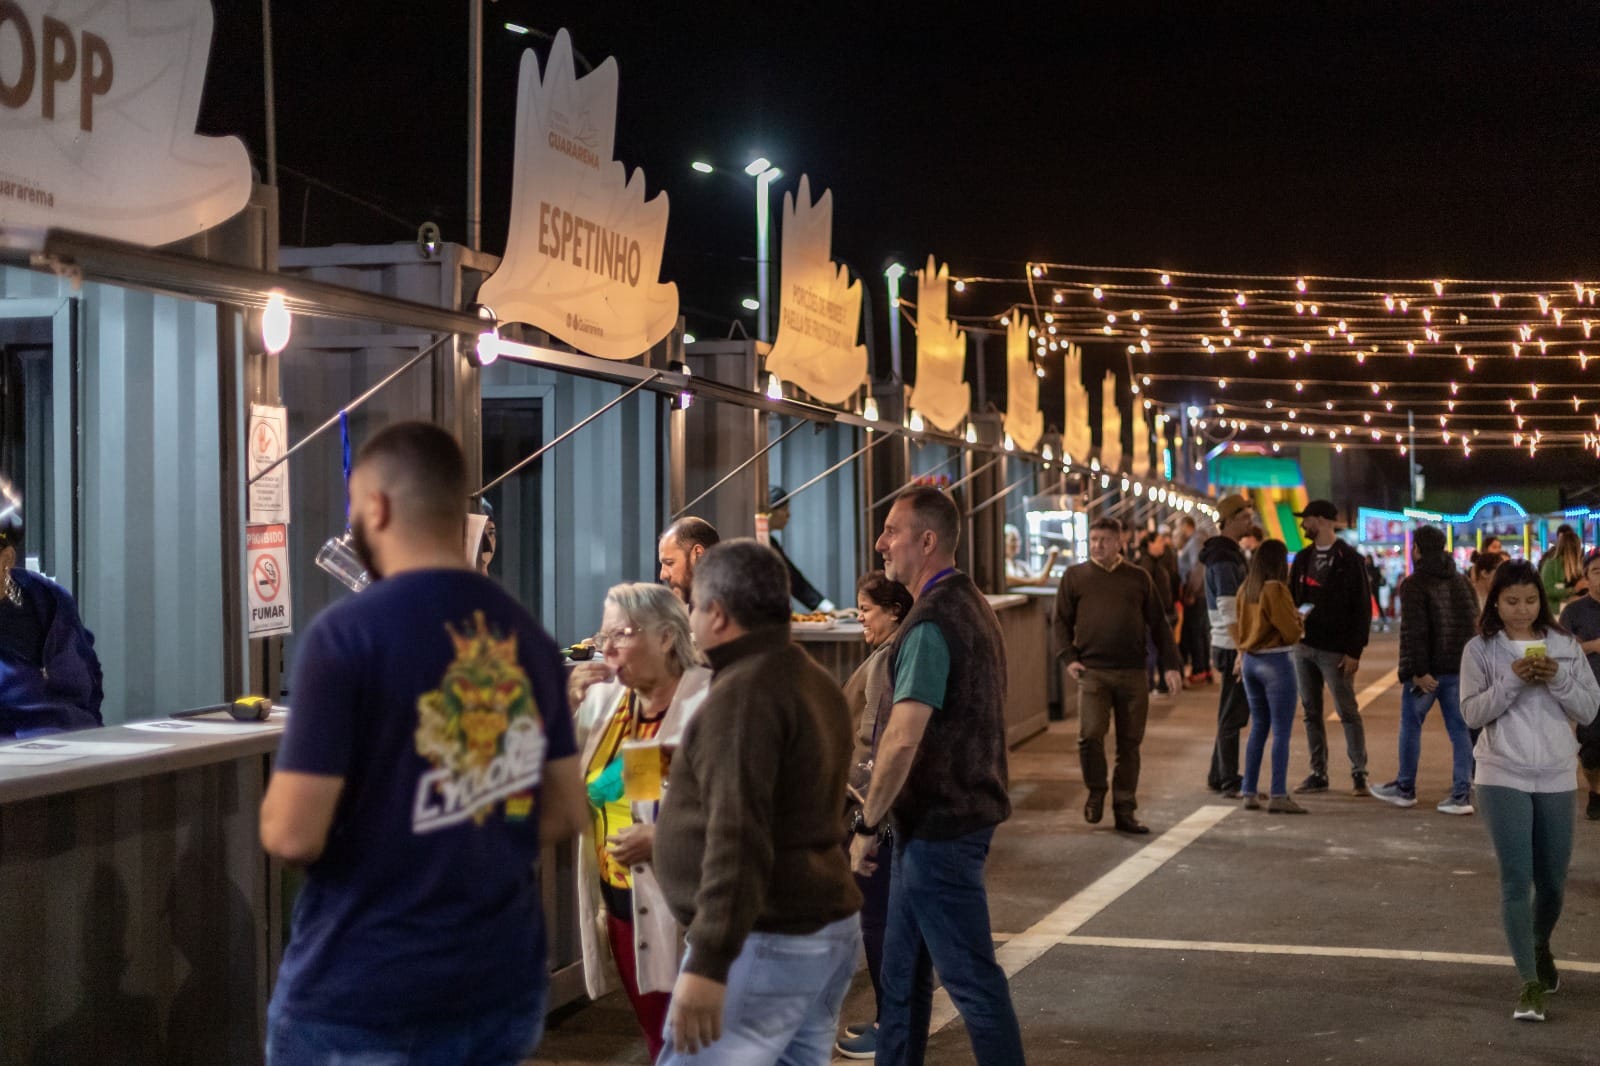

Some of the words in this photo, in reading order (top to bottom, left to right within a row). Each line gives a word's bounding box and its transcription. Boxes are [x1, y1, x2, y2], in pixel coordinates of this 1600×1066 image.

[0, 0, 113, 132] OPP
[538, 201, 641, 287] ESPETINHO
[247, 531, 284, 545] PROIBIDO
[252, 604, 285, 621] FUMAR
